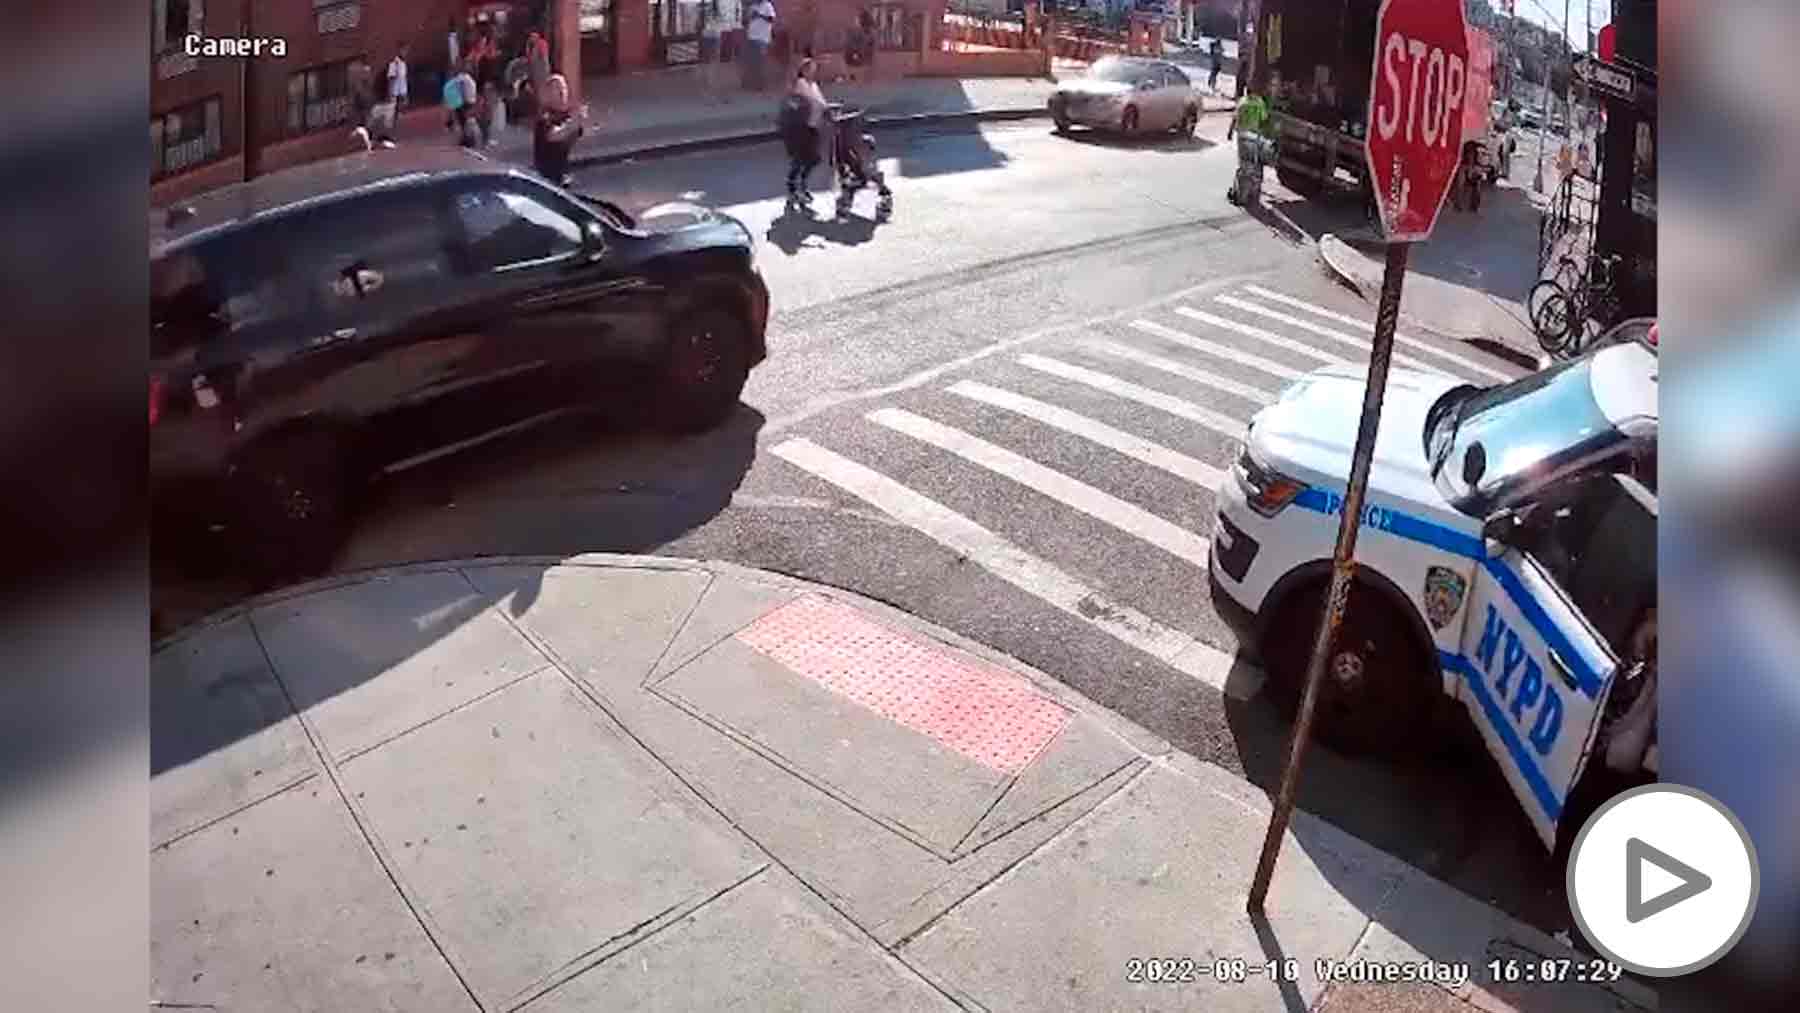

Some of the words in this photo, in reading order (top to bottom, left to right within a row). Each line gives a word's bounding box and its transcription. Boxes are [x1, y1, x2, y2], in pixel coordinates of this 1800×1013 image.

[1378, 31, 1464, 148] STOP
[1325, 489, 1392, 533] PICE
[1475, 602, 1564, 756] NYPD
